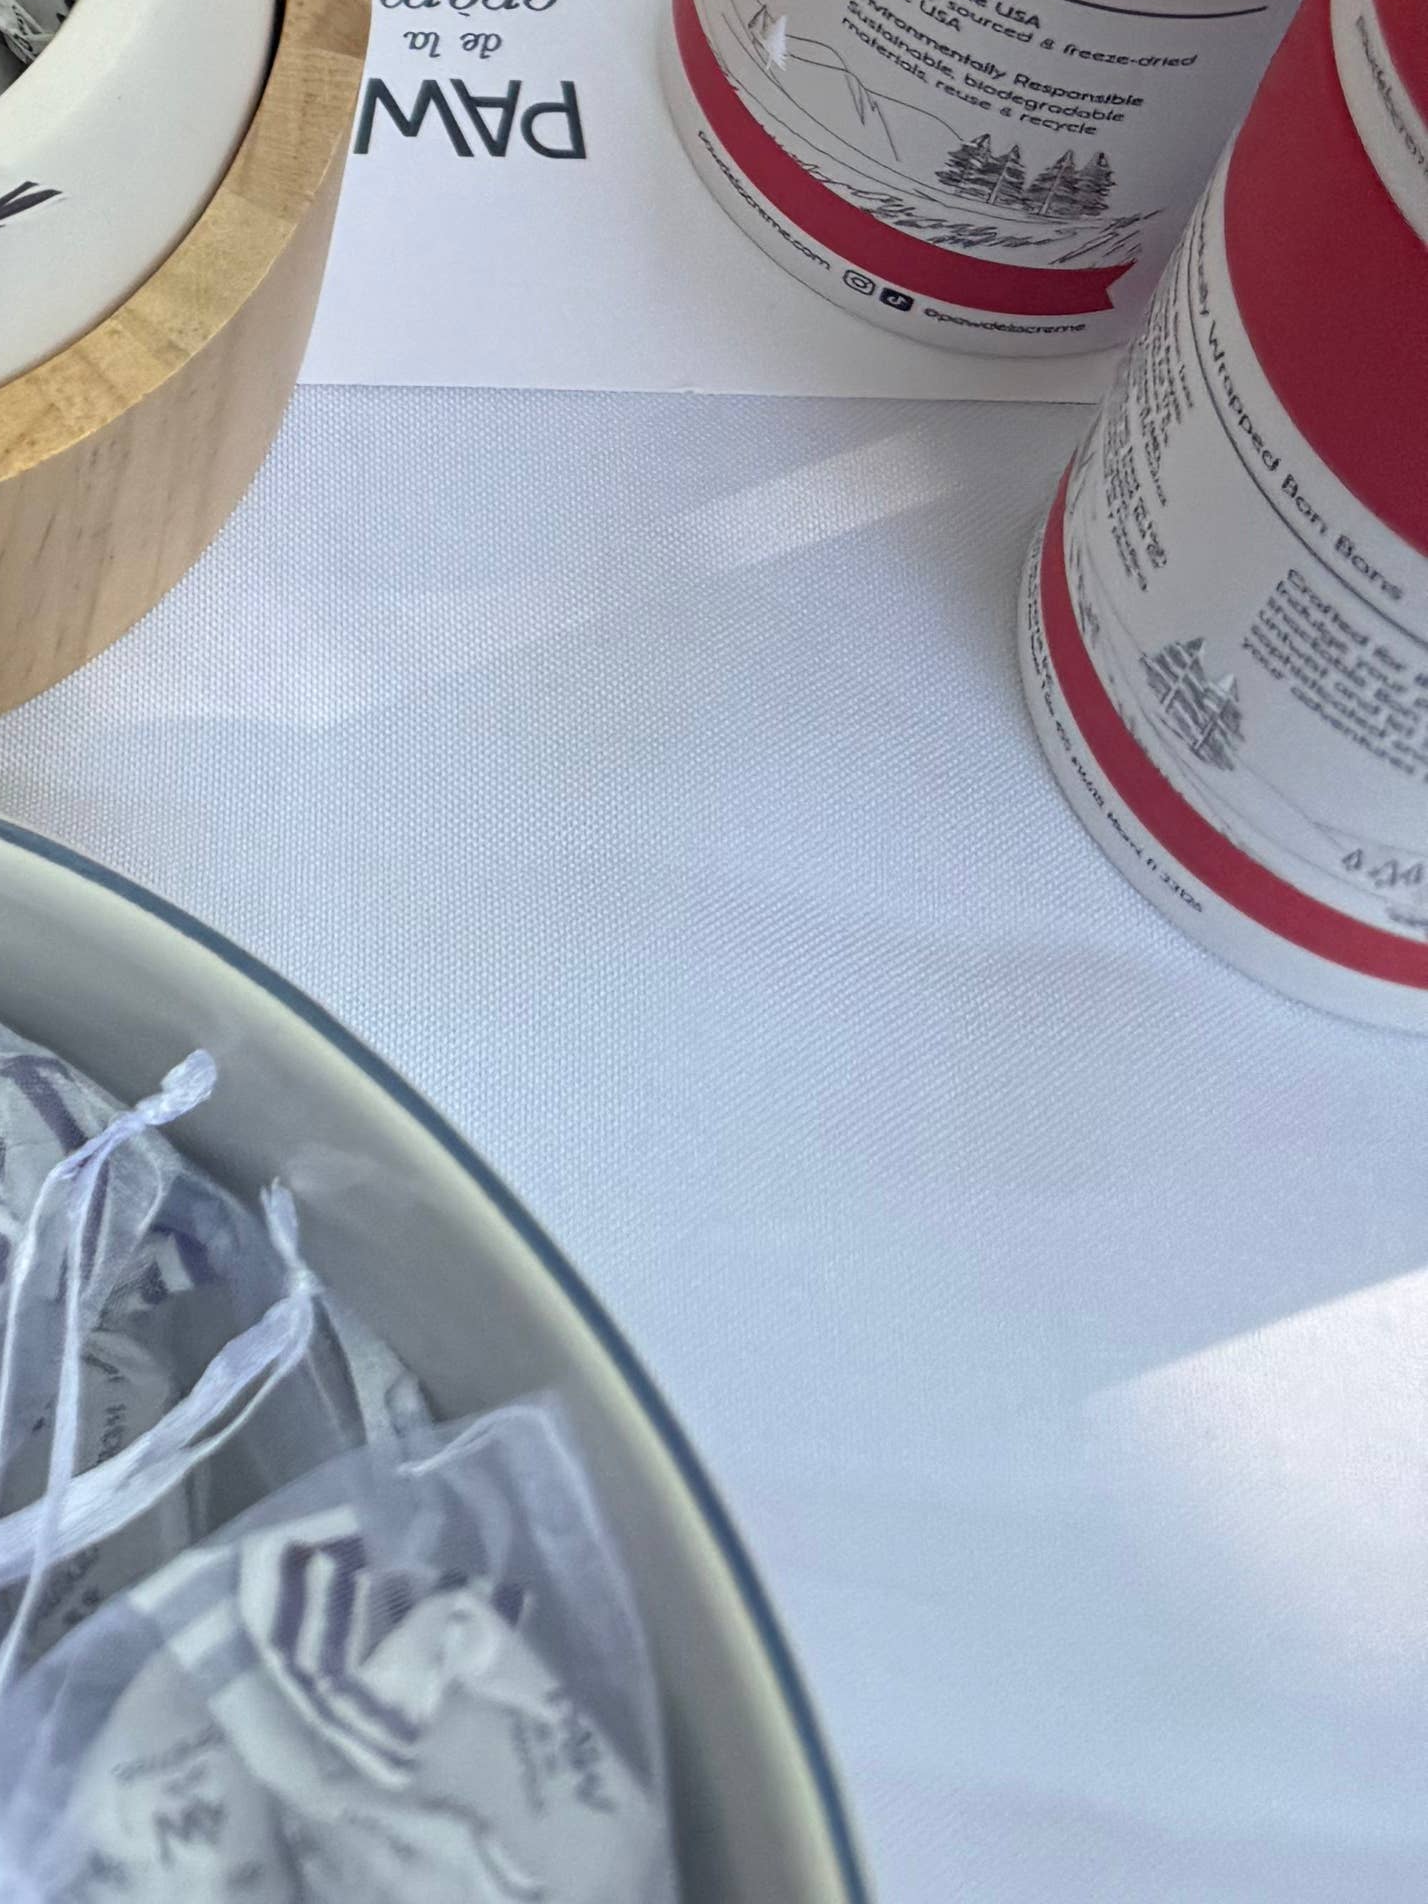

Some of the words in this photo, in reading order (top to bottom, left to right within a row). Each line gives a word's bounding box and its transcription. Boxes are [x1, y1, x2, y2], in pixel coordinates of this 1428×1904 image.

[995, 1, 1041, 29] USA
[403, 30, 440, 58] la
[460, 32, 503, 60] de
[947, 0, 1034, 44] sourced
[1063, 43, 1198, 68] freeze-dried
[964, 75, 1125, 122] biodegradable
[1014, 72, 1144, 106] Responsible
[354, 77, 586, 159] PAW
